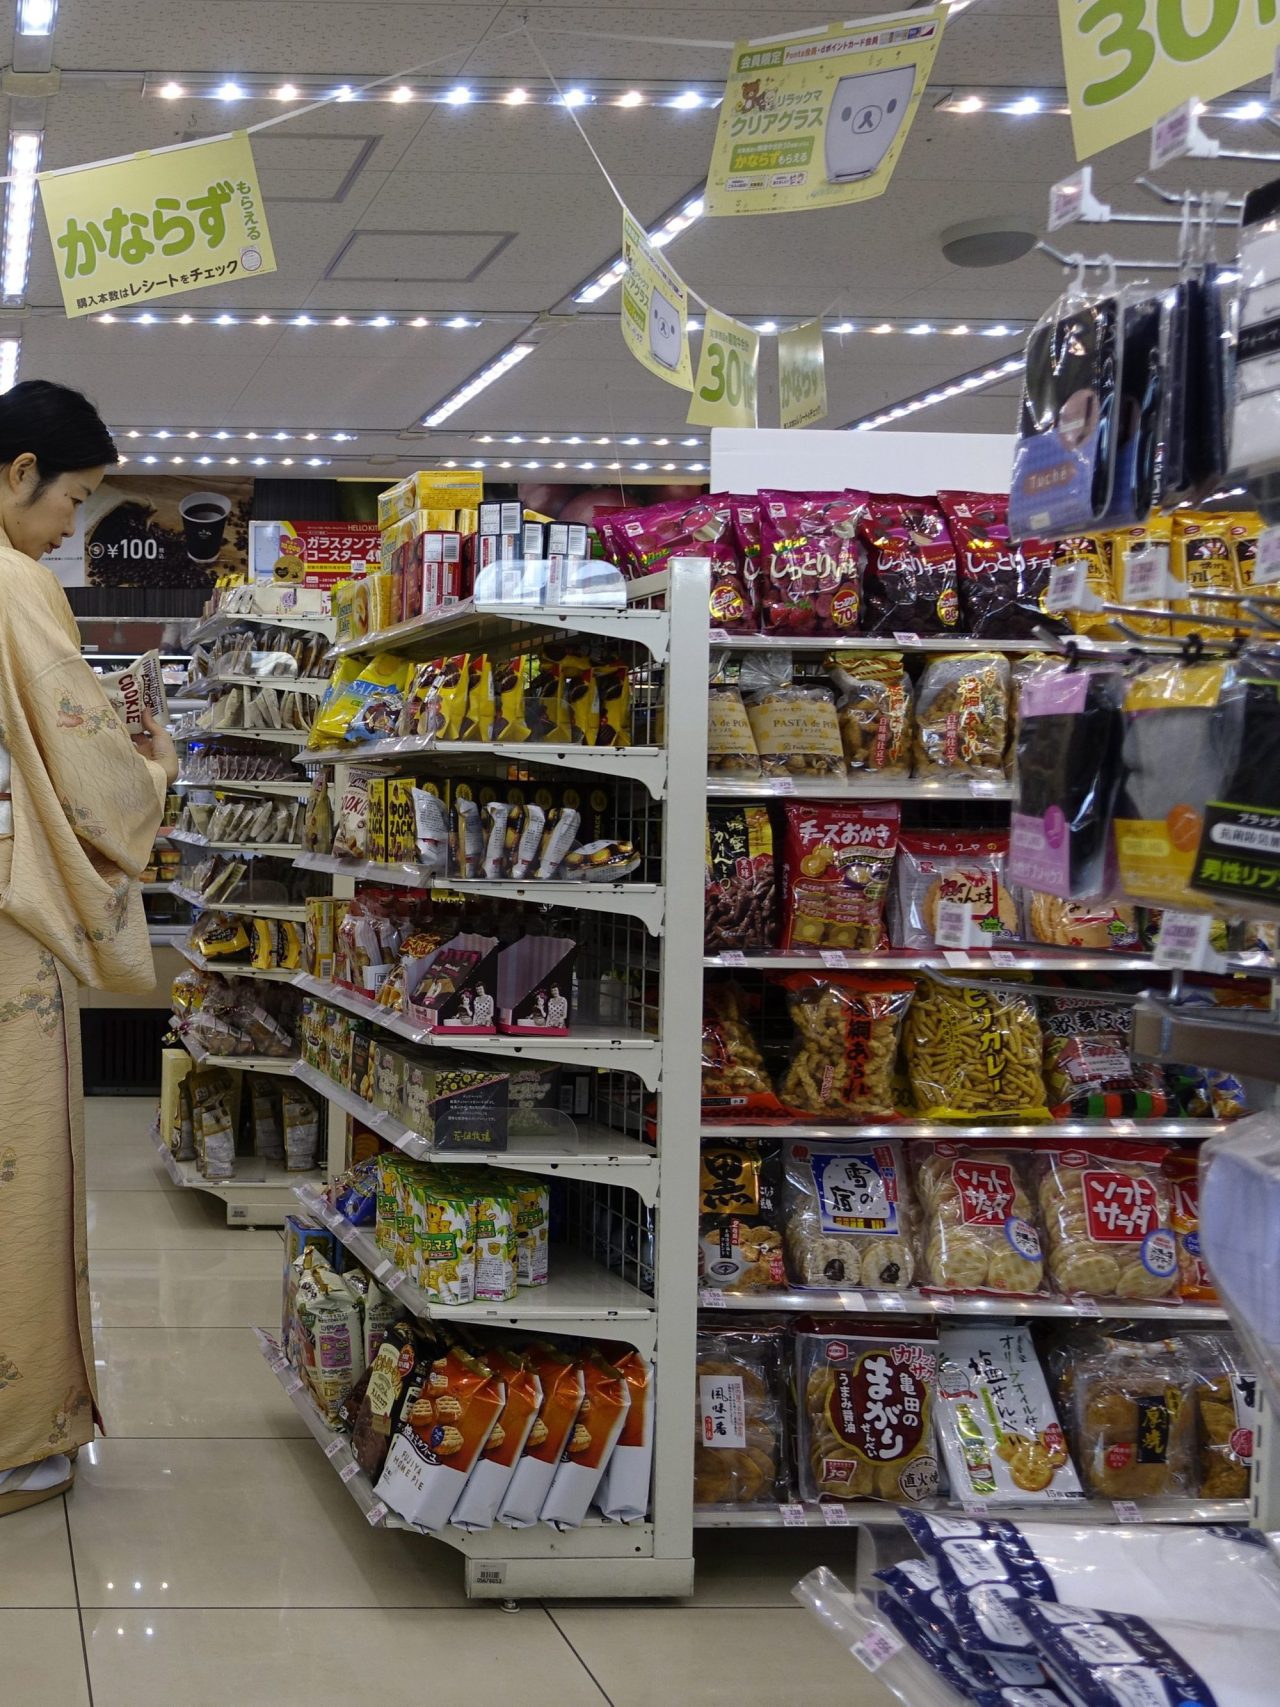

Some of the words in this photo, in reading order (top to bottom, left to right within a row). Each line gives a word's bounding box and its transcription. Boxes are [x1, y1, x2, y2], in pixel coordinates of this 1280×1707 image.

[1078, 0, 1278, 107] 30
[777, 90, 823, 107] リラックマ
[730, 106, 824, 137] クリアグラス
[236, 180, 261, 241] もらえる
[57, 180, 235, 279] かならず
[76, 259, 239, 310] 購入本数はレシートをチェック
[107, 538, 157, 560] ¥100
[307, 550, 362, 561] コースター
[118, 674, 141, 724] COOKIE
[348, 681, 395, 696] SALT
[390, 820, 413, 836] ZACK
[799, 819, 890, 848] チーズおかき
[1090, 1179, 1152, 1205] ソフト
[1092, 1200, 1153, 1236] サラダ
[863, 1356, 904, 1460] まがり
[899, 1371, 920, 1427] 亀田の
